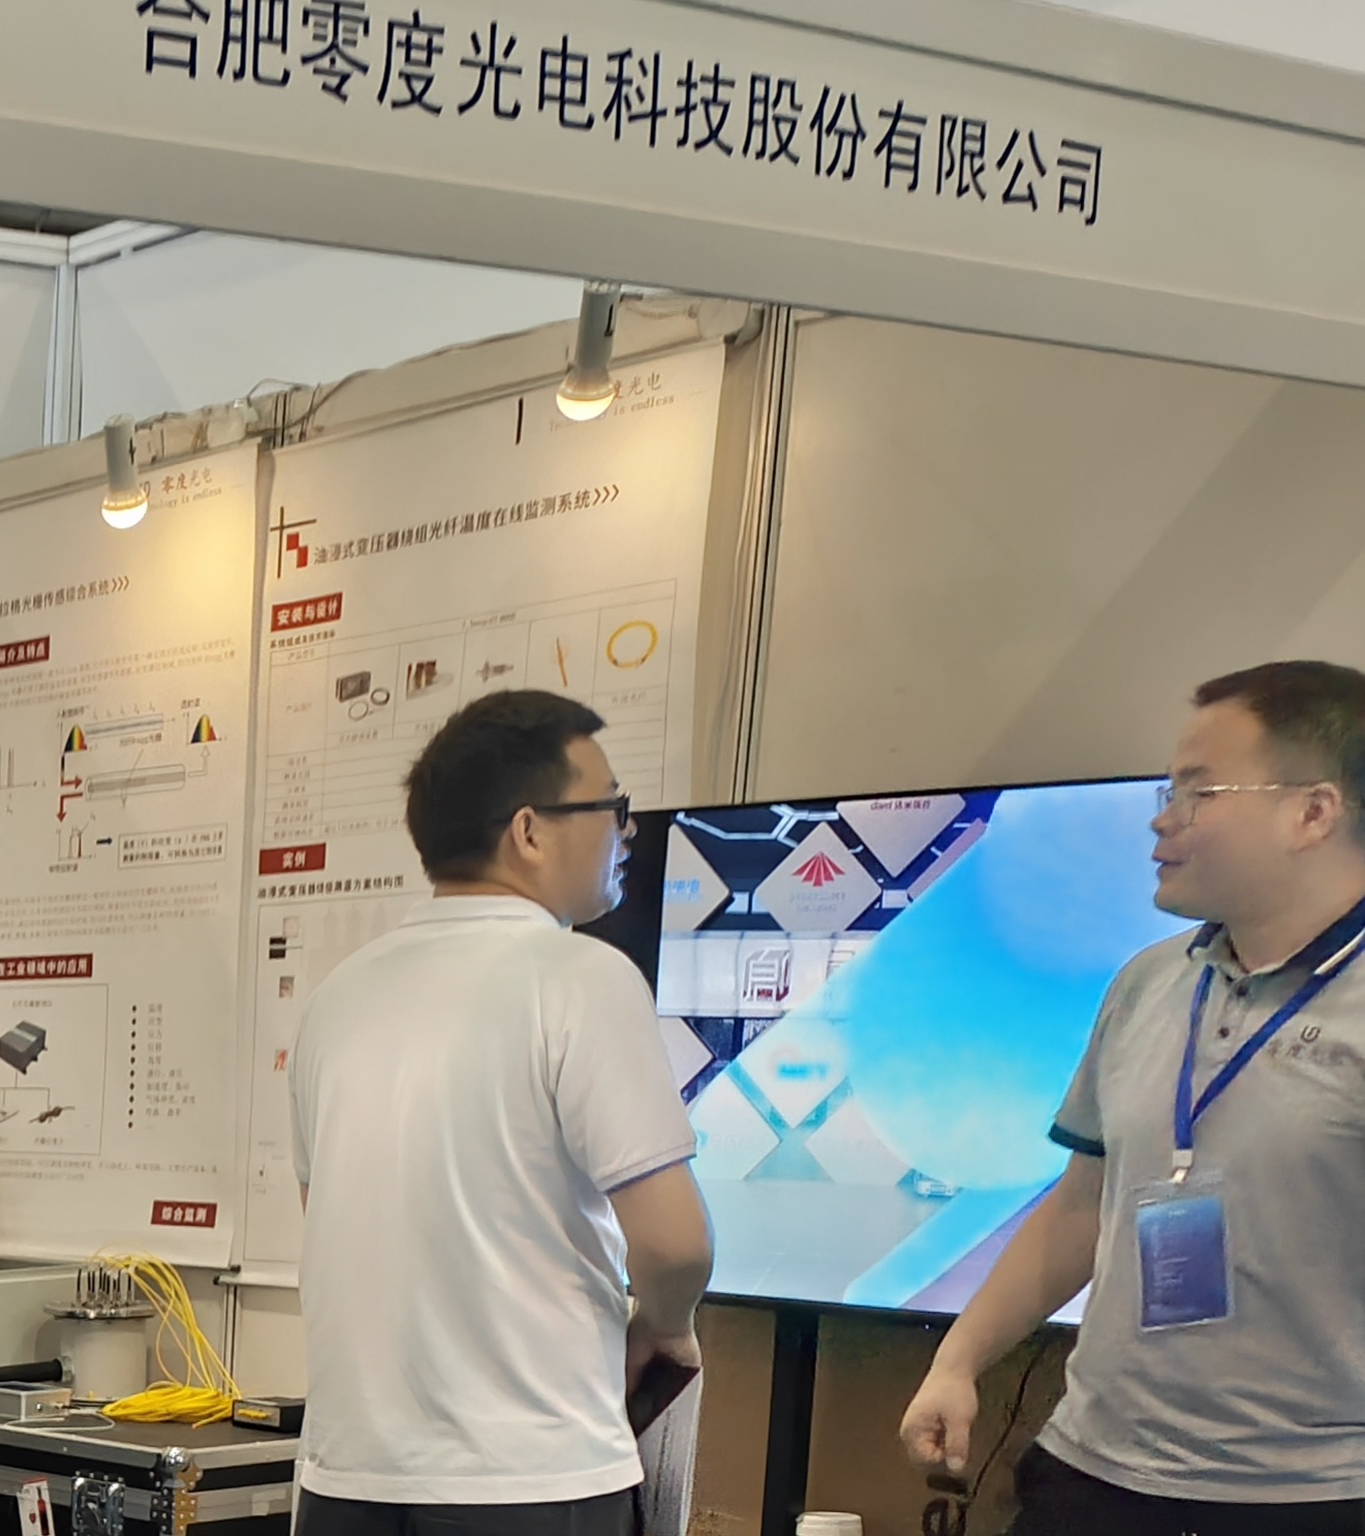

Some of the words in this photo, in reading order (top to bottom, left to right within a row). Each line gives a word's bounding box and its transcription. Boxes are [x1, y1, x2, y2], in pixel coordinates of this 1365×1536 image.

[136, 0, 1105, 227] 合肥零度光电科技股份有限公司
[277, 599, 339, 626] 安装与设计
[281, 851, 307, 869] 实例
